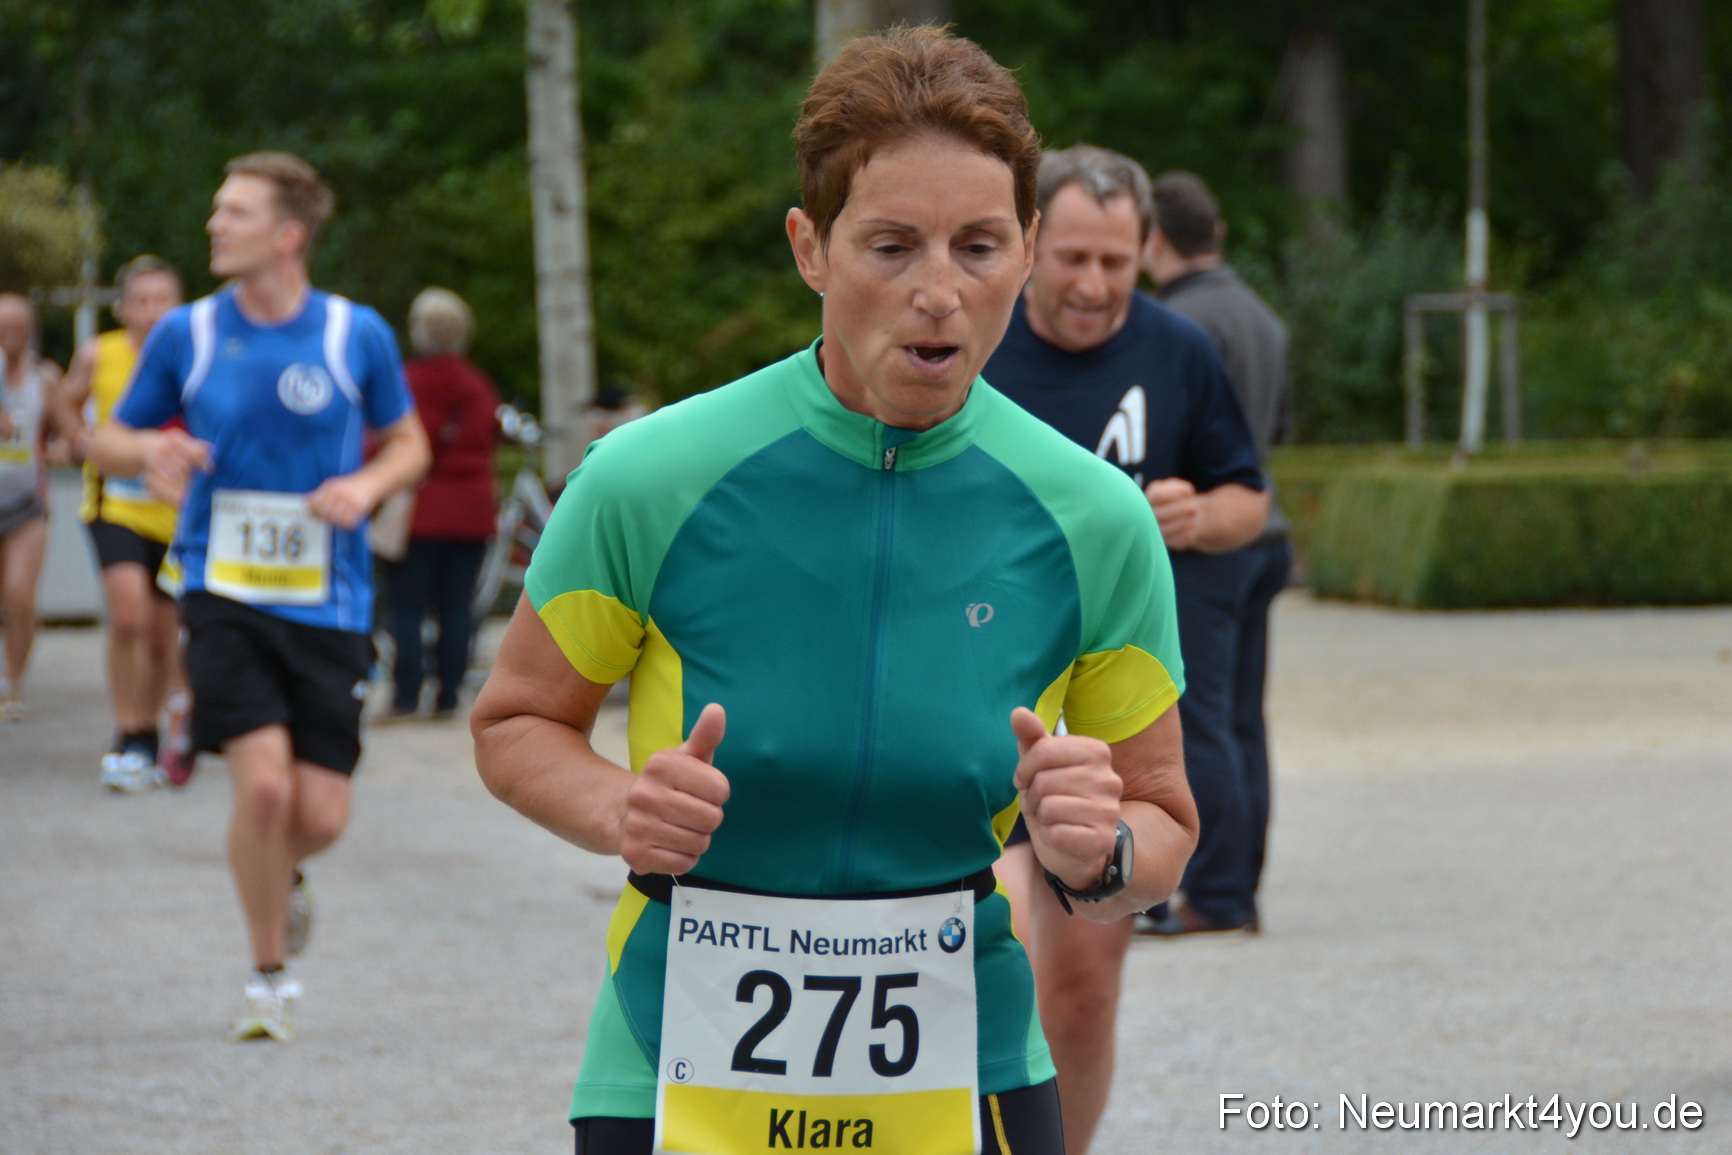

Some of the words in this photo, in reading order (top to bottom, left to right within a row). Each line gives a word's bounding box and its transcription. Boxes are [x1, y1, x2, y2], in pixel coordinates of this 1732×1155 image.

[238, 522, 306, 560] 136
[677, 917, 780, 953] PARTL
[789, 928, 928, 956] Neumarkt
[730, 969, 920, 1078] 275
[674, 1061, 687, 1080] C
[767, 1108, 874, 1149] Klara
